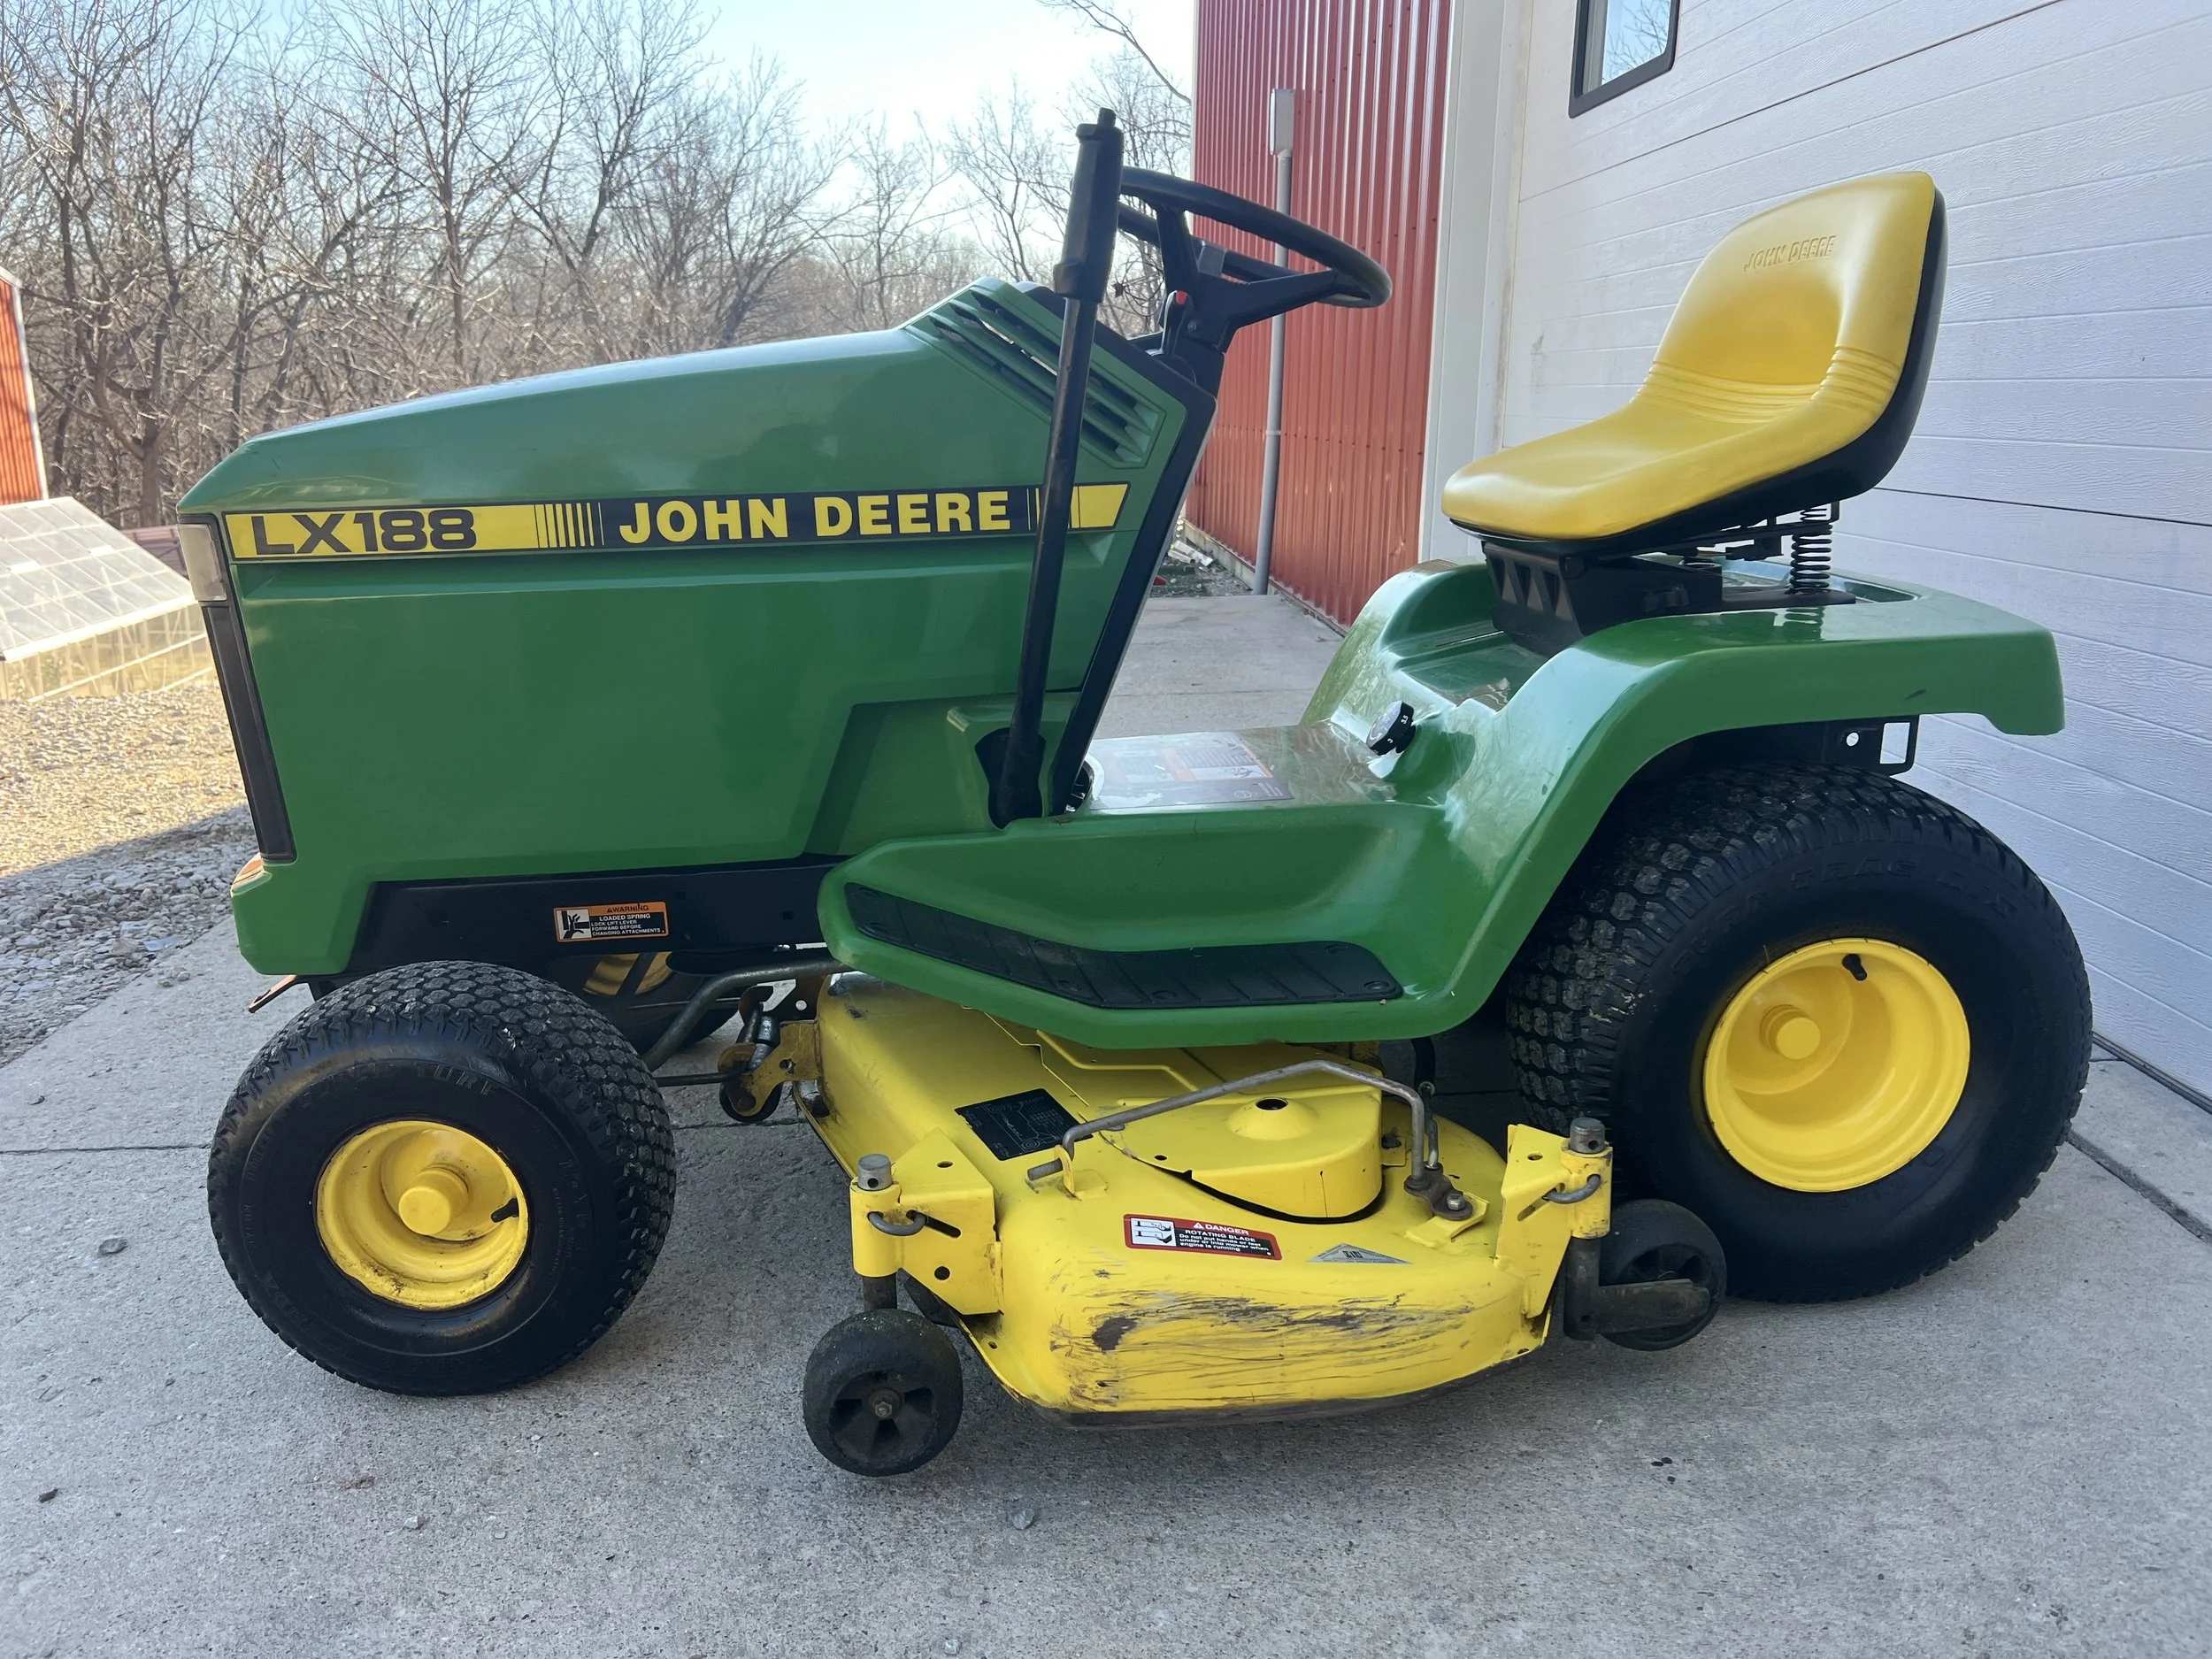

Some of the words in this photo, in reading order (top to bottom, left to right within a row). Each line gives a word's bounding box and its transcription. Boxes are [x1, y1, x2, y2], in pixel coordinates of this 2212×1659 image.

[1743, 244, 1787, 272] JOHN
[1787, 234, 1836, 262] DEERE
[251, 509, 477, 556] LX188
[618, 497, 788, 543] JOHN
[813, 491, 1010, 537] DEERE
[1185, 1230, 1227, 1239] ROTATING
[1205, 1224, 1249, 1235] DANGER
